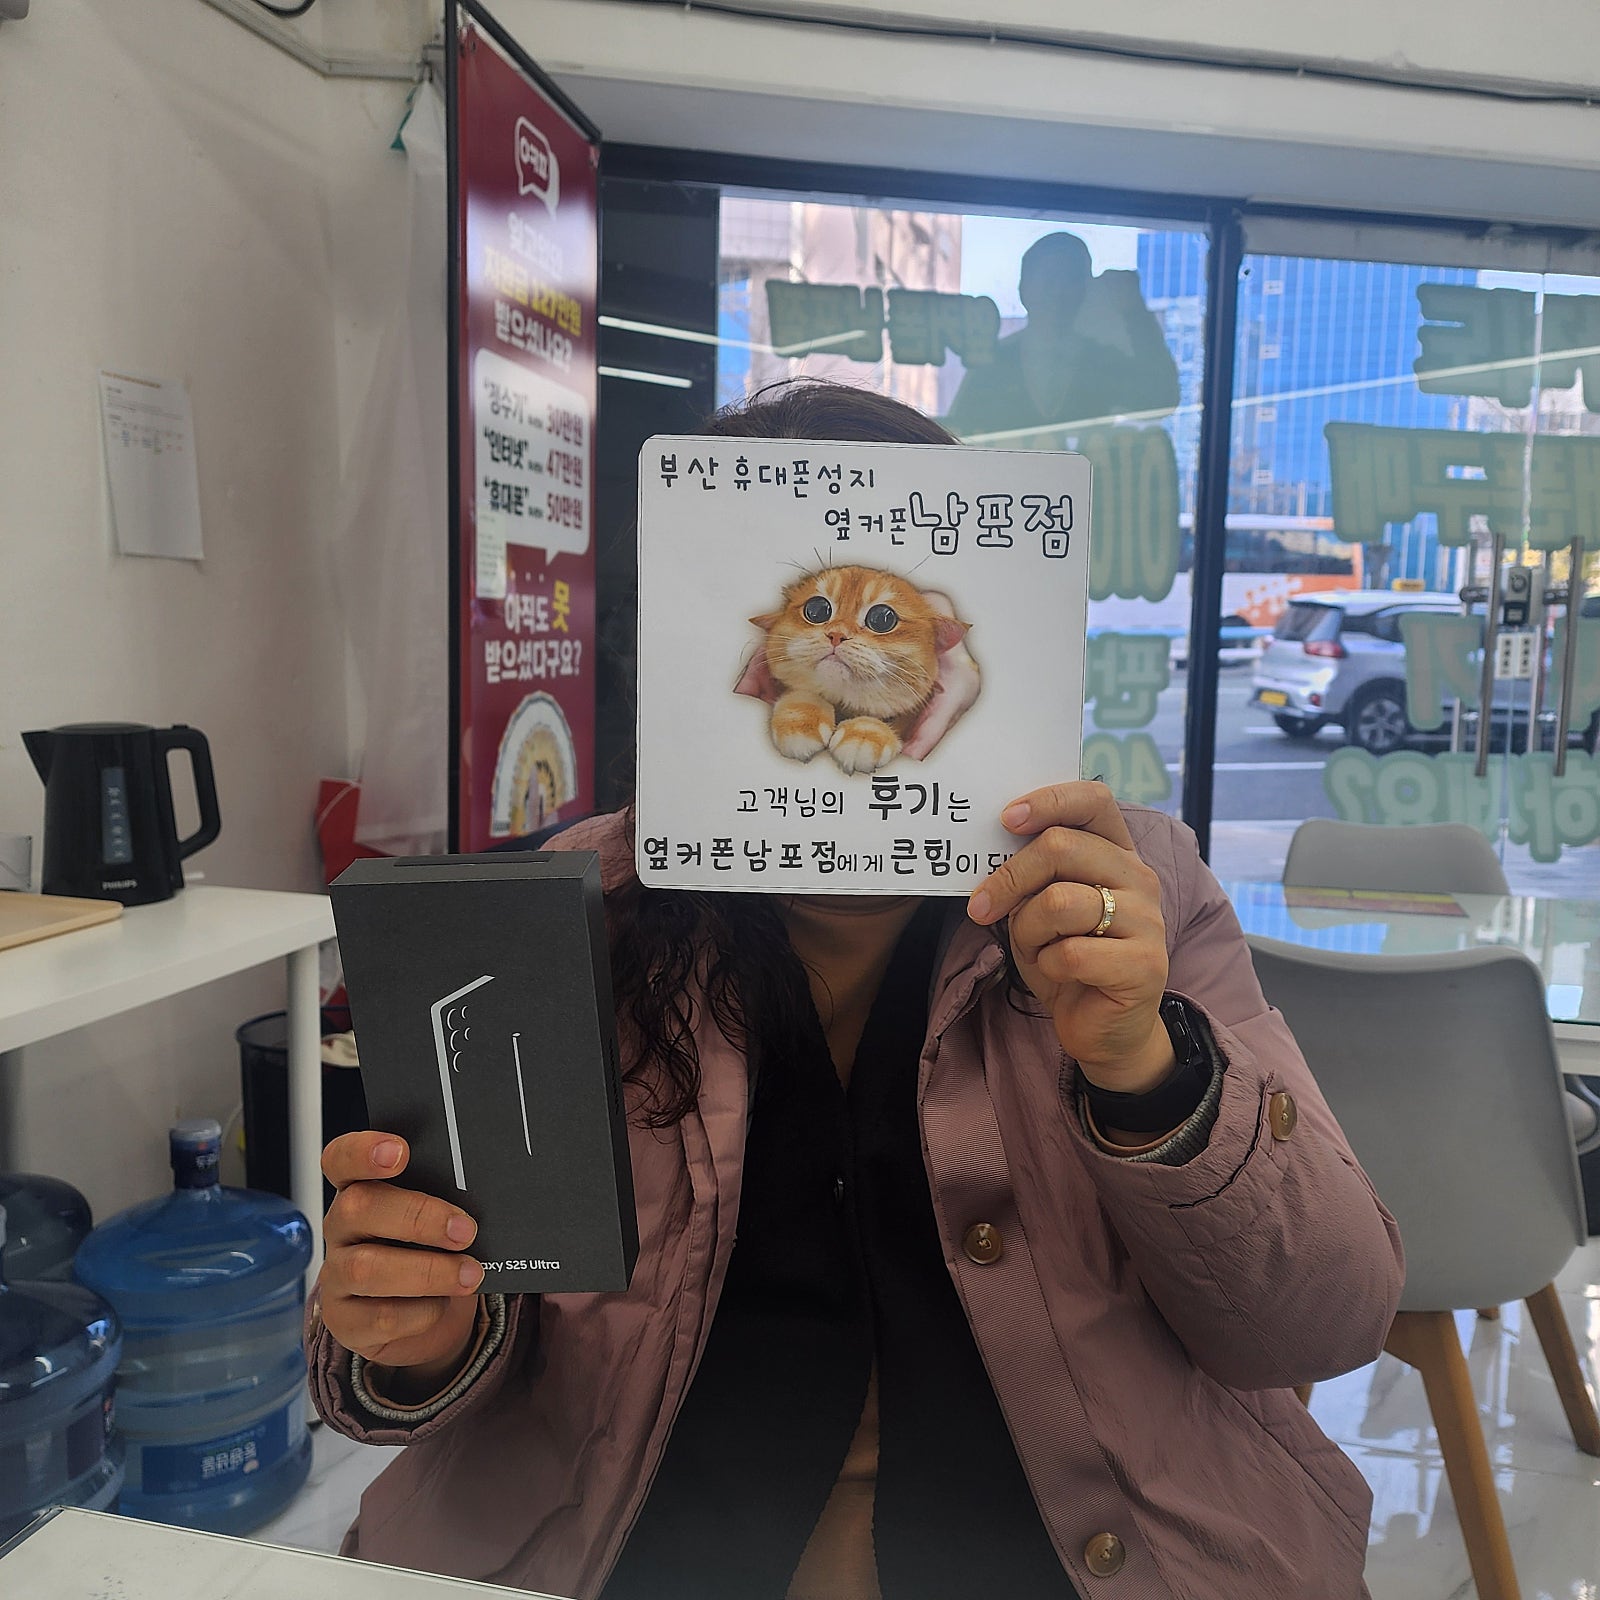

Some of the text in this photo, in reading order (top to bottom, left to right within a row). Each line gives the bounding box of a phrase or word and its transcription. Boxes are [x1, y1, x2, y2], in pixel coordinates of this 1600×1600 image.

[547, 405, 583, 447] 30만원
[547, 448, 583, 488] 47만원
[660, 453, 875, 498] 부산 휴대폰성지
[547, 492, 583, 530] 50만원
[824, 491, 1074, 558] 옆커폰 남포점
[504, 580, 570, 634] 아직도 못
[485, 640, 582, 684] 받으셨다구요?
[736, 787, 844, 818] 고객님의
[505, 1260, 527, 1270] S25
[529, 1259, 560, 1270] Ultra
